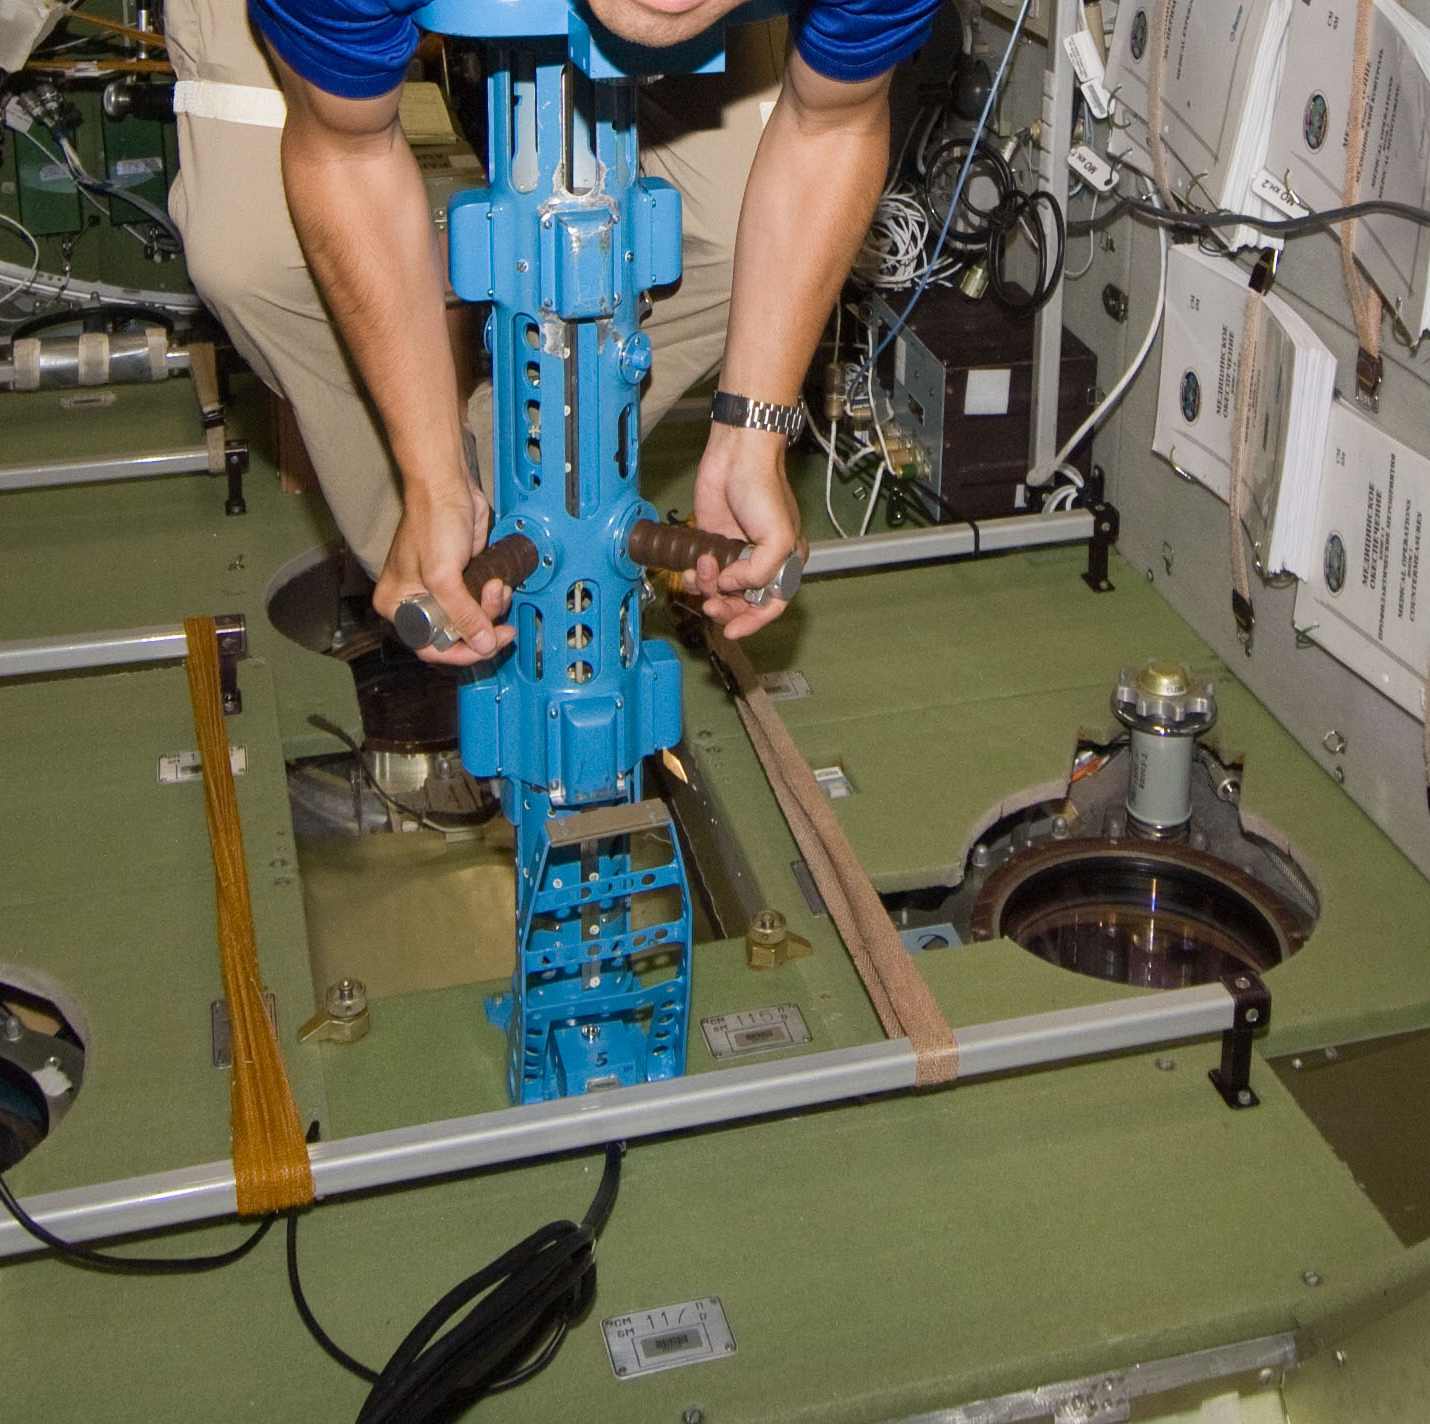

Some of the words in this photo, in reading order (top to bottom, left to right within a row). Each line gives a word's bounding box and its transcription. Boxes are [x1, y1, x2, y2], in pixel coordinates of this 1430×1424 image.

[1215, 324, 1229, 417] МЕДИЦИНСКОЕ
[1222, 330, 1234, 419] ОБЕСПЕЧЕНИЕ
[1361, 479, 1375, 587] МЕДИЦИНСКОЕ
[1369, 488, 1383, 590] ОБЕСПЕЧЕНИЕ
[1401, 497, 1412, 567] OPERATIONS
[1409, 510, 1423, 623] COUNTERMEASURES
[1377, 531, 1391, 641] ПРОФИЛАКТИЧЕСКИЕ
[1396, 570, 1408, 620] MEDICAL
[595, 1051, 609, 1068] 5
